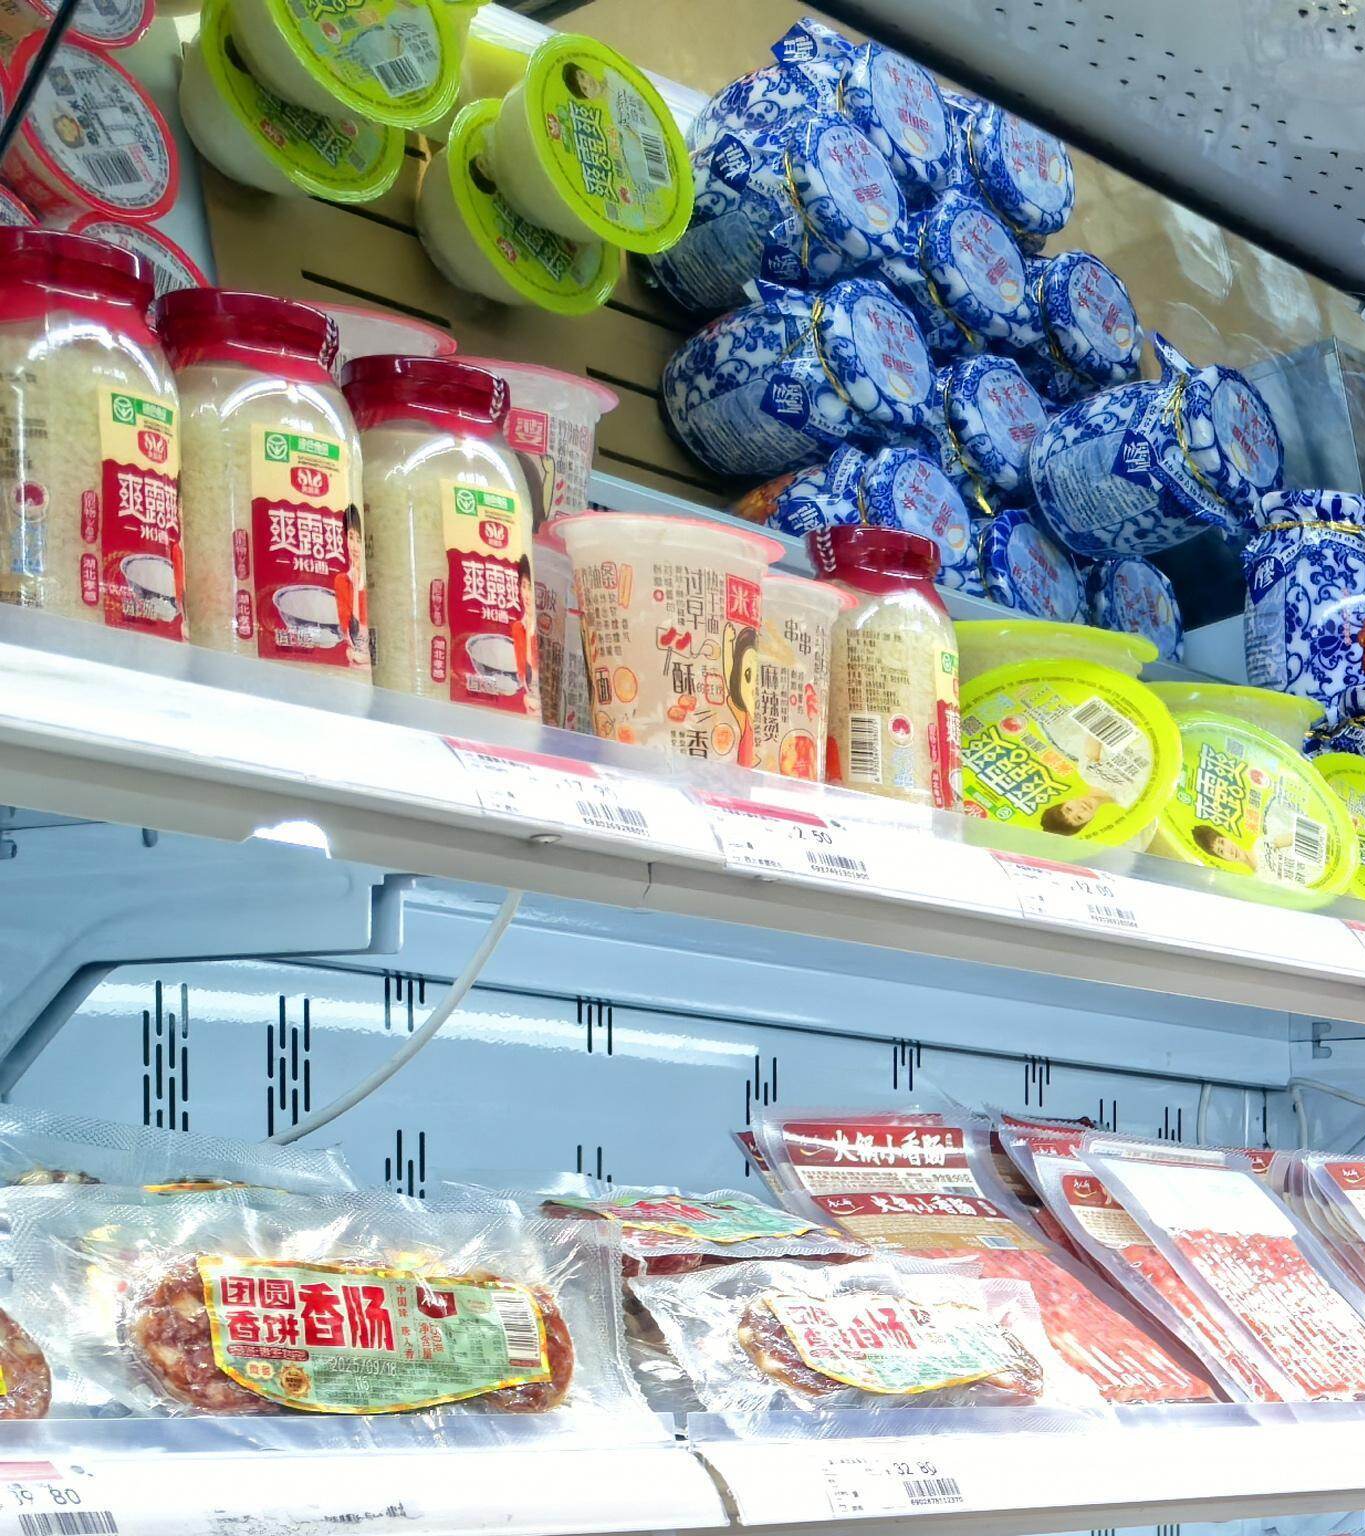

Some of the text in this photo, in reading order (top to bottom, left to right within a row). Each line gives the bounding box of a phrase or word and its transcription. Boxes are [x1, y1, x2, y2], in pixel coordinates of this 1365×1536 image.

[269, 509, 346, 563] 爽露爽
[834, 1129, 947, 1165] 火锅小香肠
[219, 1275, 296, 1310] 团圆
[225, 1310, 300, 1346] 香饼
[299, 1282, 395, 1351] 香肠
